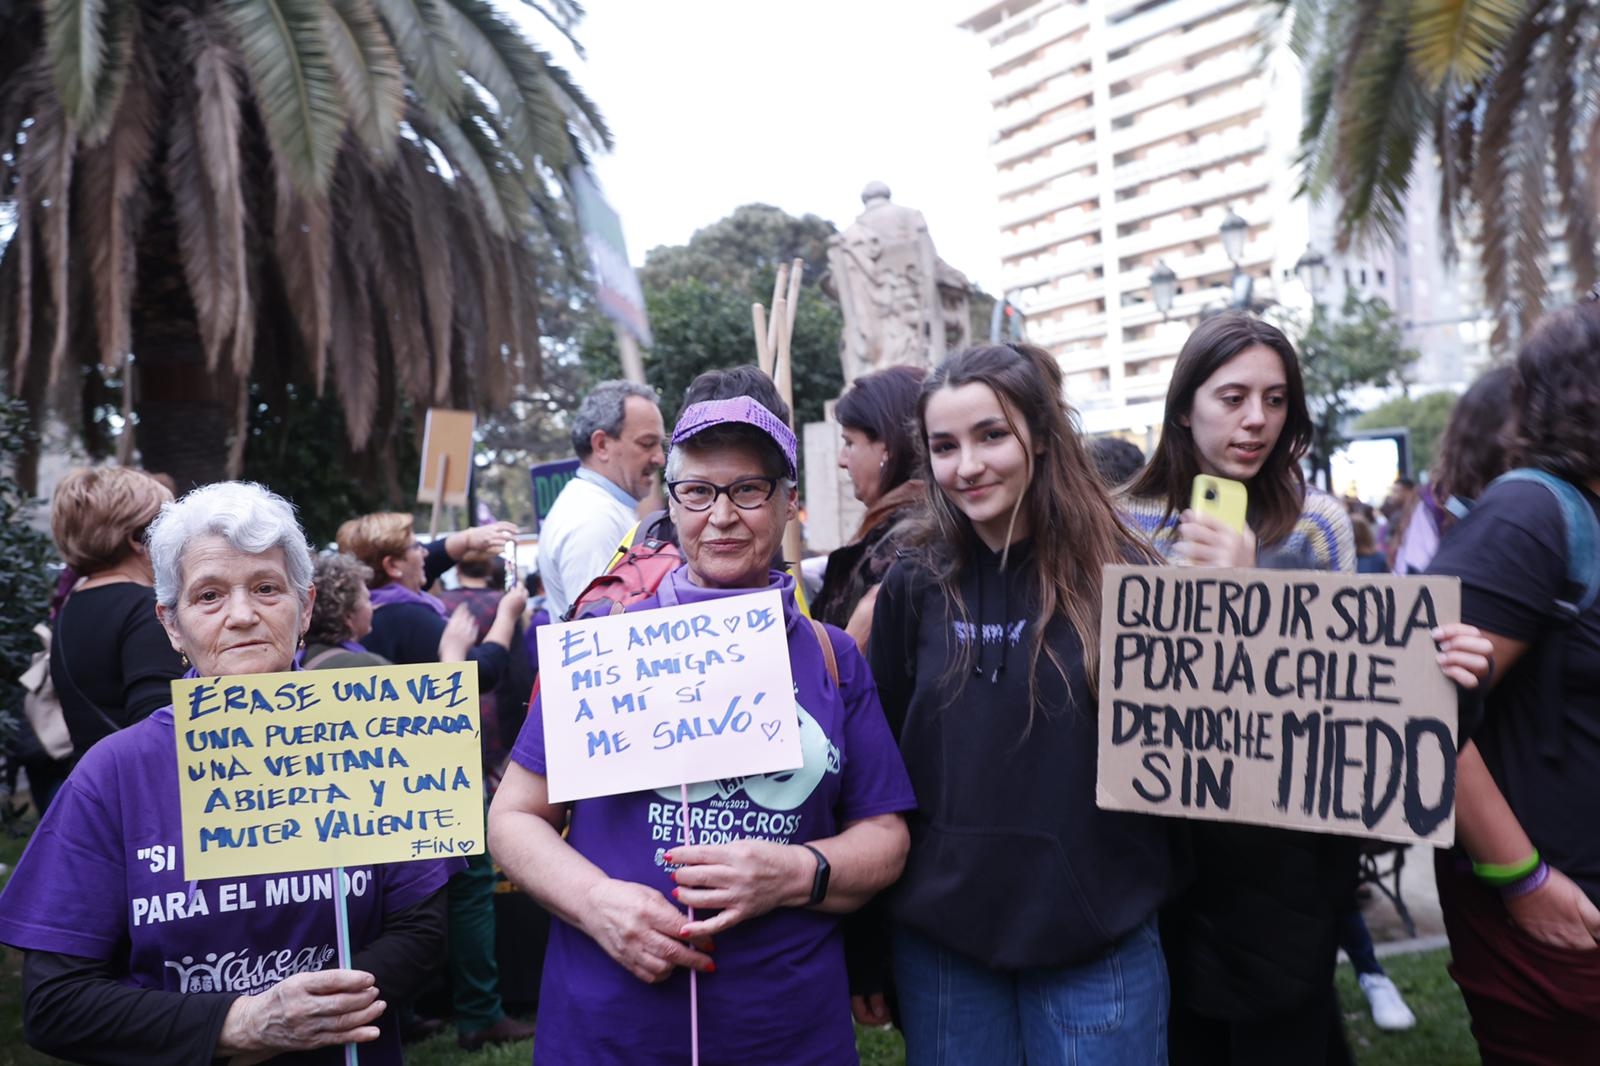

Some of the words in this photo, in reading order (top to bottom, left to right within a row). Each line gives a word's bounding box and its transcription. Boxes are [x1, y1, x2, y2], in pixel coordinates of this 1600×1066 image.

[1117, 575, 1271, 637] QUIERO
[1279, 583, 1320, 641] IR
[1326, 585, 1444, 651] SOLA
[559, 630, 613, 667] EL
[627, 615, 720, 651] AMOR
[746, 607, 777, 633] DE
[571, 663, 621, 691] MIS
[636, 644, 745, 682] AMIGAS
[1113, 633, 1204, 692] POR
[1213, 640, 1256, 694] LA
[1264, 648, 1401, 704] CALLE
[189, 677, 321, 721] ÉRASE
[332, 675, 400, 702] UNA
[406, 671, 469, 708] VEZ
[574, 698, 594, 723] A
[611, 686, 653, 714] MÍ
[675, 681, 706, 703] SÍ
[185, 727, 254, 752] UNA
[266, 720, 359, 747] PUERTA
[365, 714, 480, 739] CERRADA,
[586, 730, 631, 758] ME
[653, 692, 767, 750] SALVÓ
[188, 755, 251, 782] UNA
[263, 747, 409, 777] VENTANA
[1132, 751, 1234, 809] SIN
[1276, 706, 1457, 836] MIEDO
[204, 783, 351, 813] ABIERTA
[369, 779, 386, 807] Y
[404, 766, 470, 793] UNA
[315, 809, 461, 843] VALIENTE.
[652, 825, 673, 841] DE
[132, 890, 210, 926] PARA
[219, 882, 256, 913] EL
